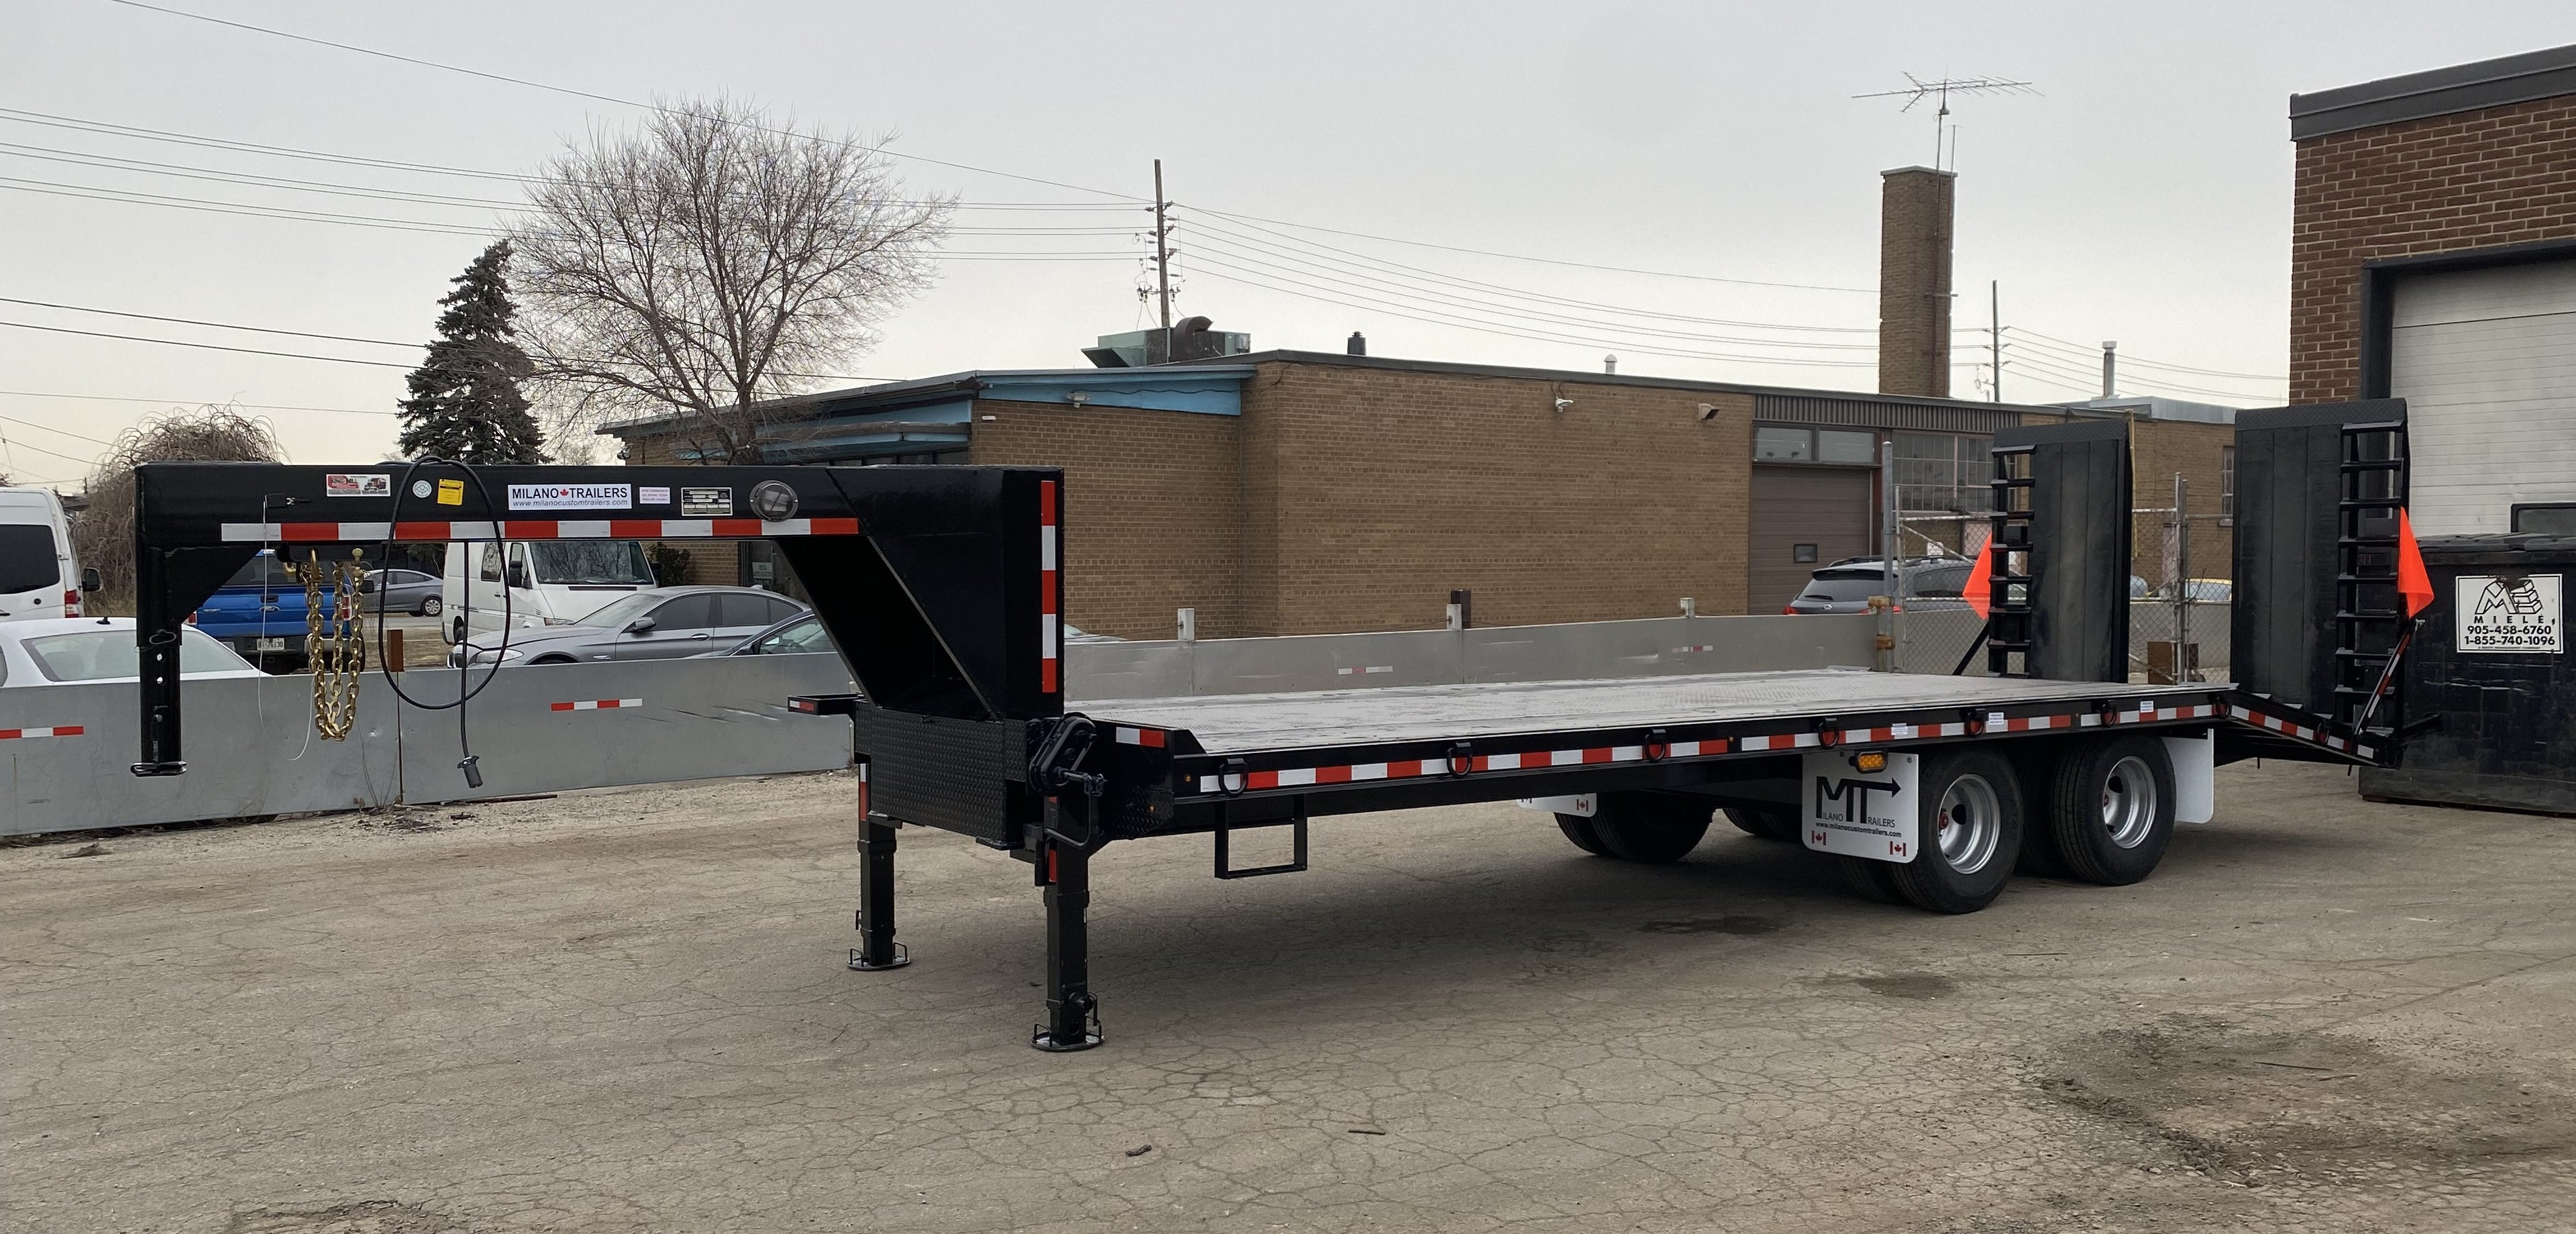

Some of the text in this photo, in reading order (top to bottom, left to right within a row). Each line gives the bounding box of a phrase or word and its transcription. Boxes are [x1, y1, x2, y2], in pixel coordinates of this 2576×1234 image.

[513, 488, 627, 499] MILANO TRAILERS
[2473, 615, 2544, 623] MIELE
[2467, 625, 2552, 635] 905-458-6760
[2464, 635, 2555, 646] 1-855-740-1096
[1815, 822, 1902, 838] www.milanocustomtrailers.com
